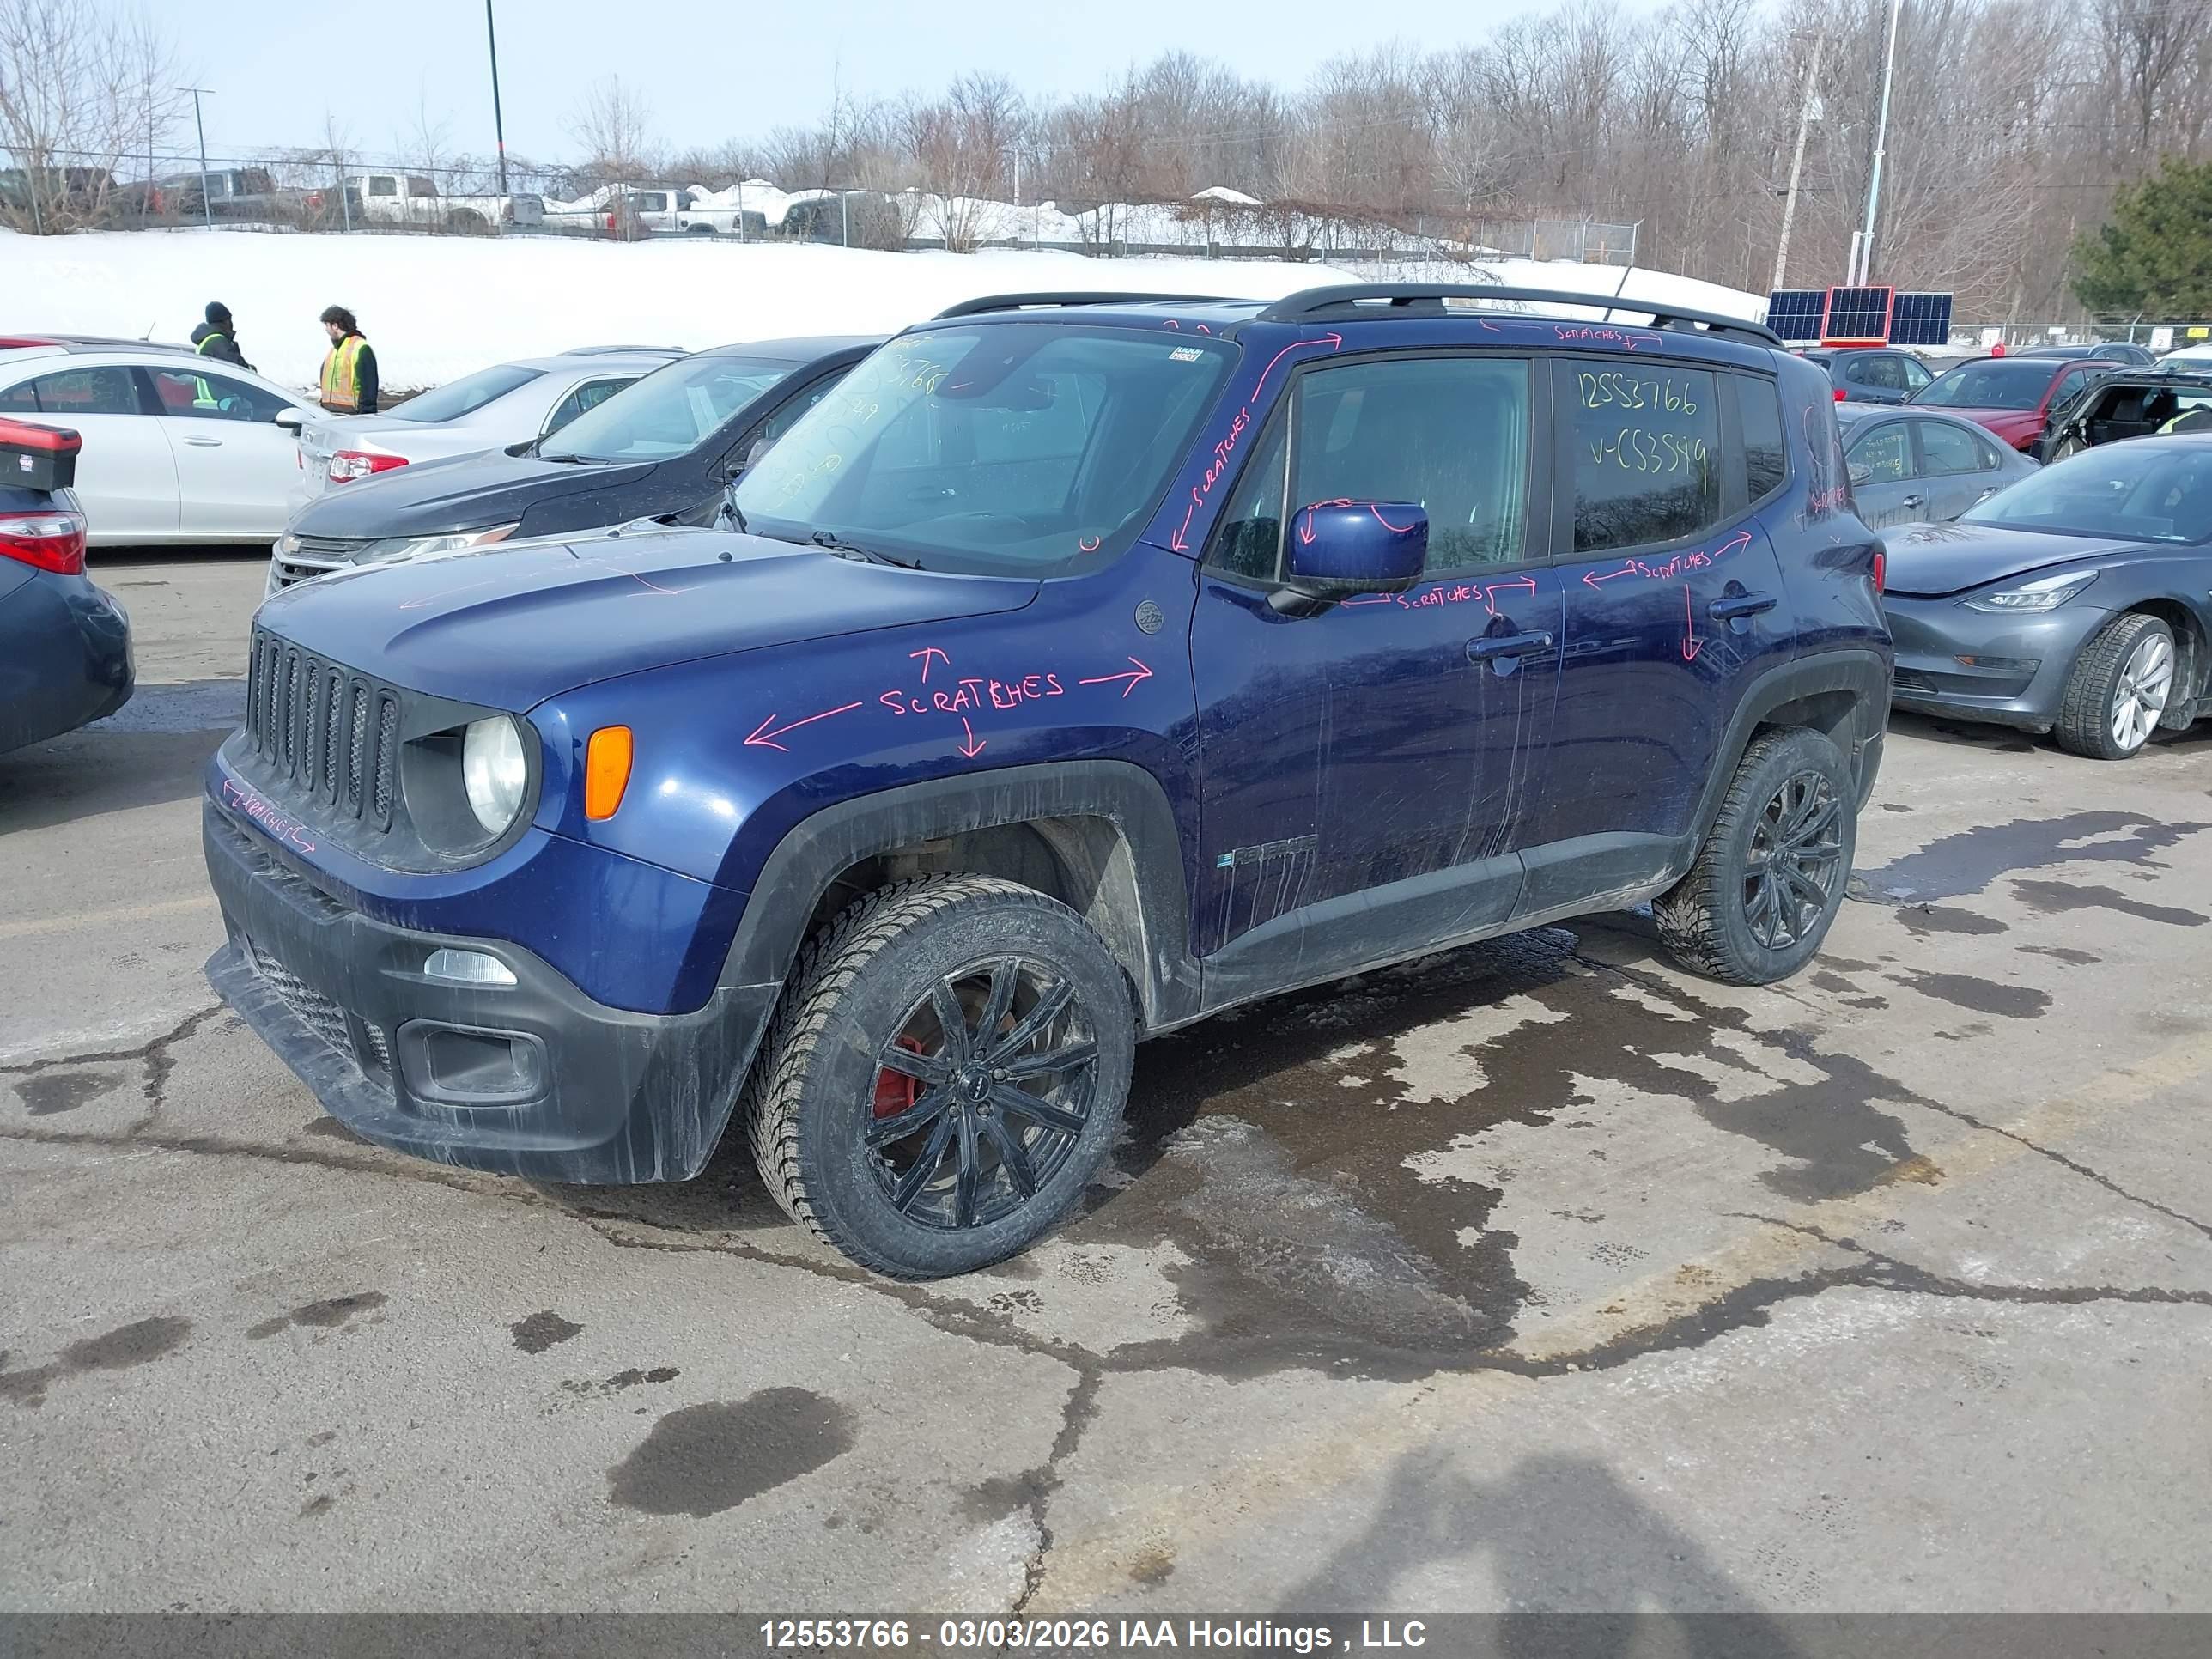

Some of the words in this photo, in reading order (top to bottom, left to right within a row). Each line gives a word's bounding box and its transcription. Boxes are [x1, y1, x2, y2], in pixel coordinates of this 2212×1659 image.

[1192, 407, 1251, 508] SCRATCHES
[1638, 551, 1711, 580] SCRATCHES
[1396, 585, 1484, 610] SCRATCHES
